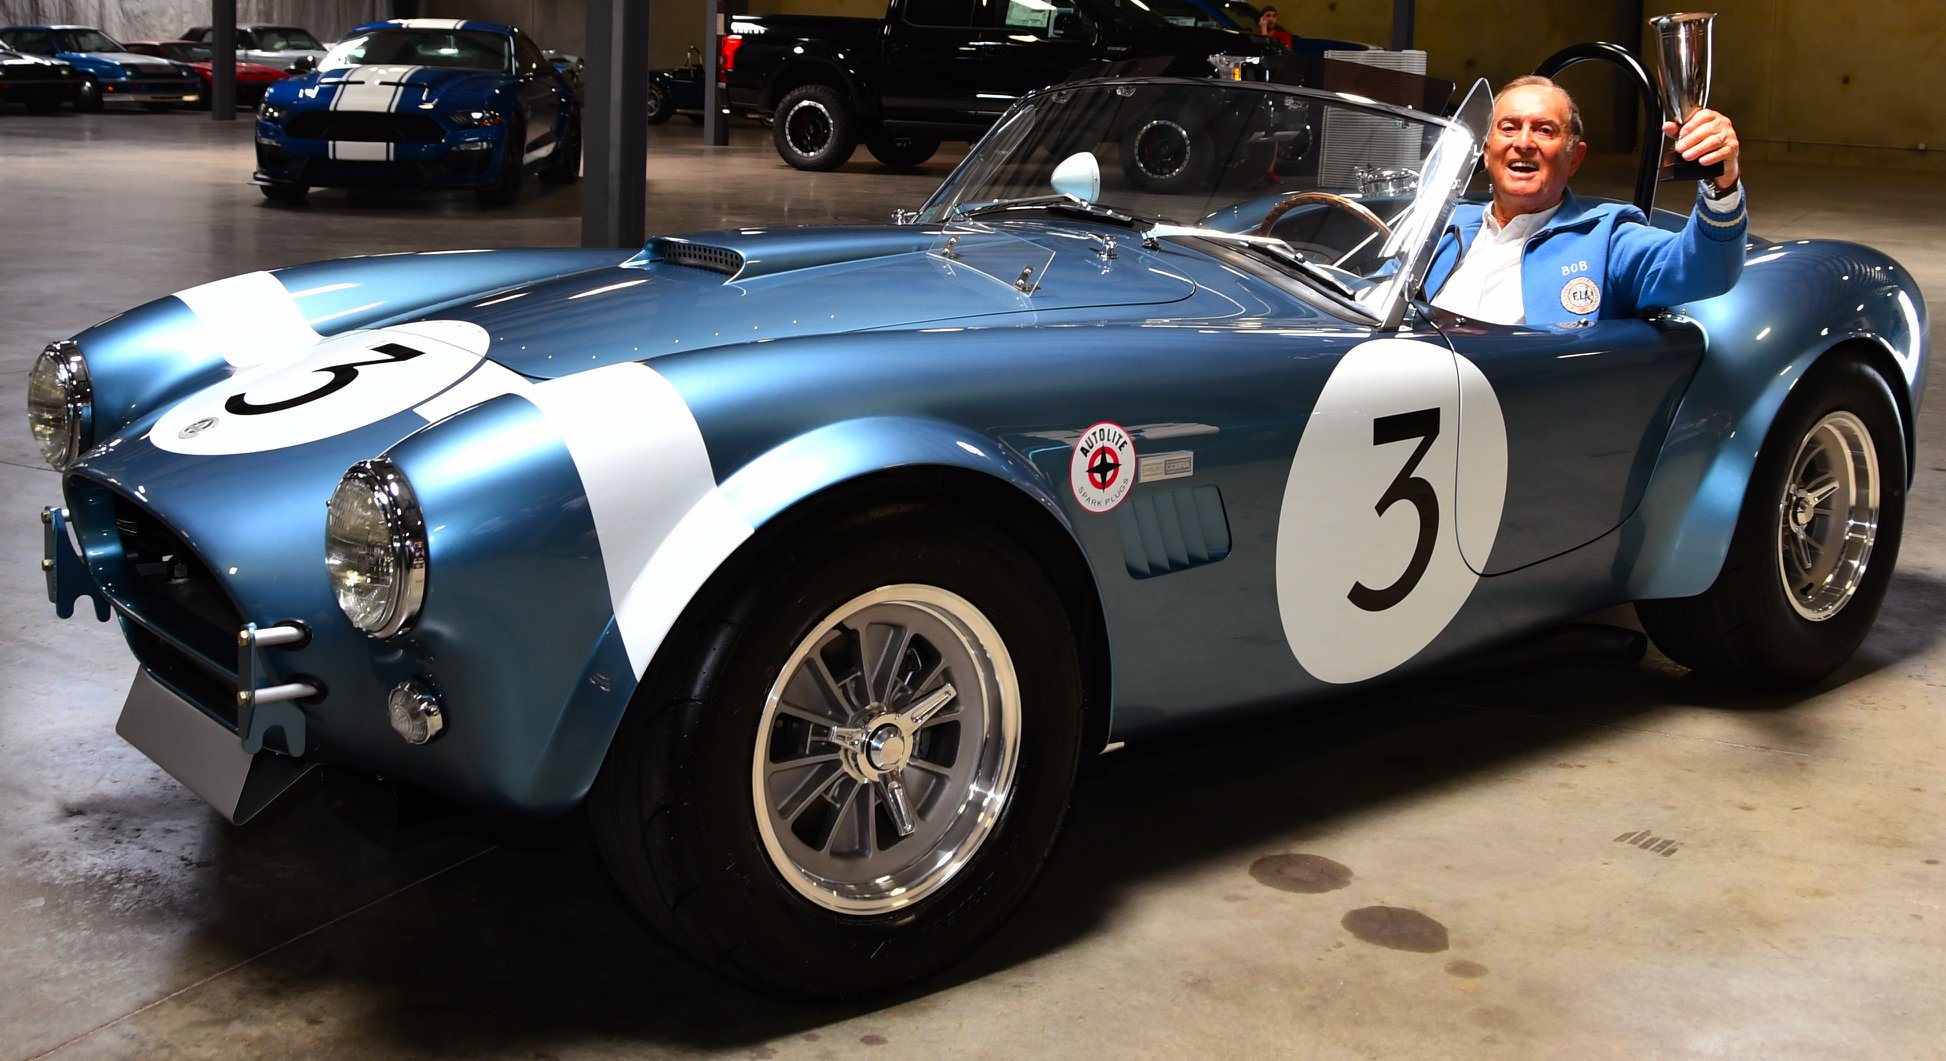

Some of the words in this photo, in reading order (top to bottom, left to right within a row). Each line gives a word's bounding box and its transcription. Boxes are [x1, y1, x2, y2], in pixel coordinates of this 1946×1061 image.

[1561, 260, 1588, 276] BOB
[225, 343, 425, 415] 3
[1079, 428, 1128, 458] AUTOLITE
[1166, 460, 1191, 471] COBRA
[1077, 485, 1103, 507] SPARK
[1104, 477, 1130, 506] PLUGS
[1347, 407, 1440, 611] 3
